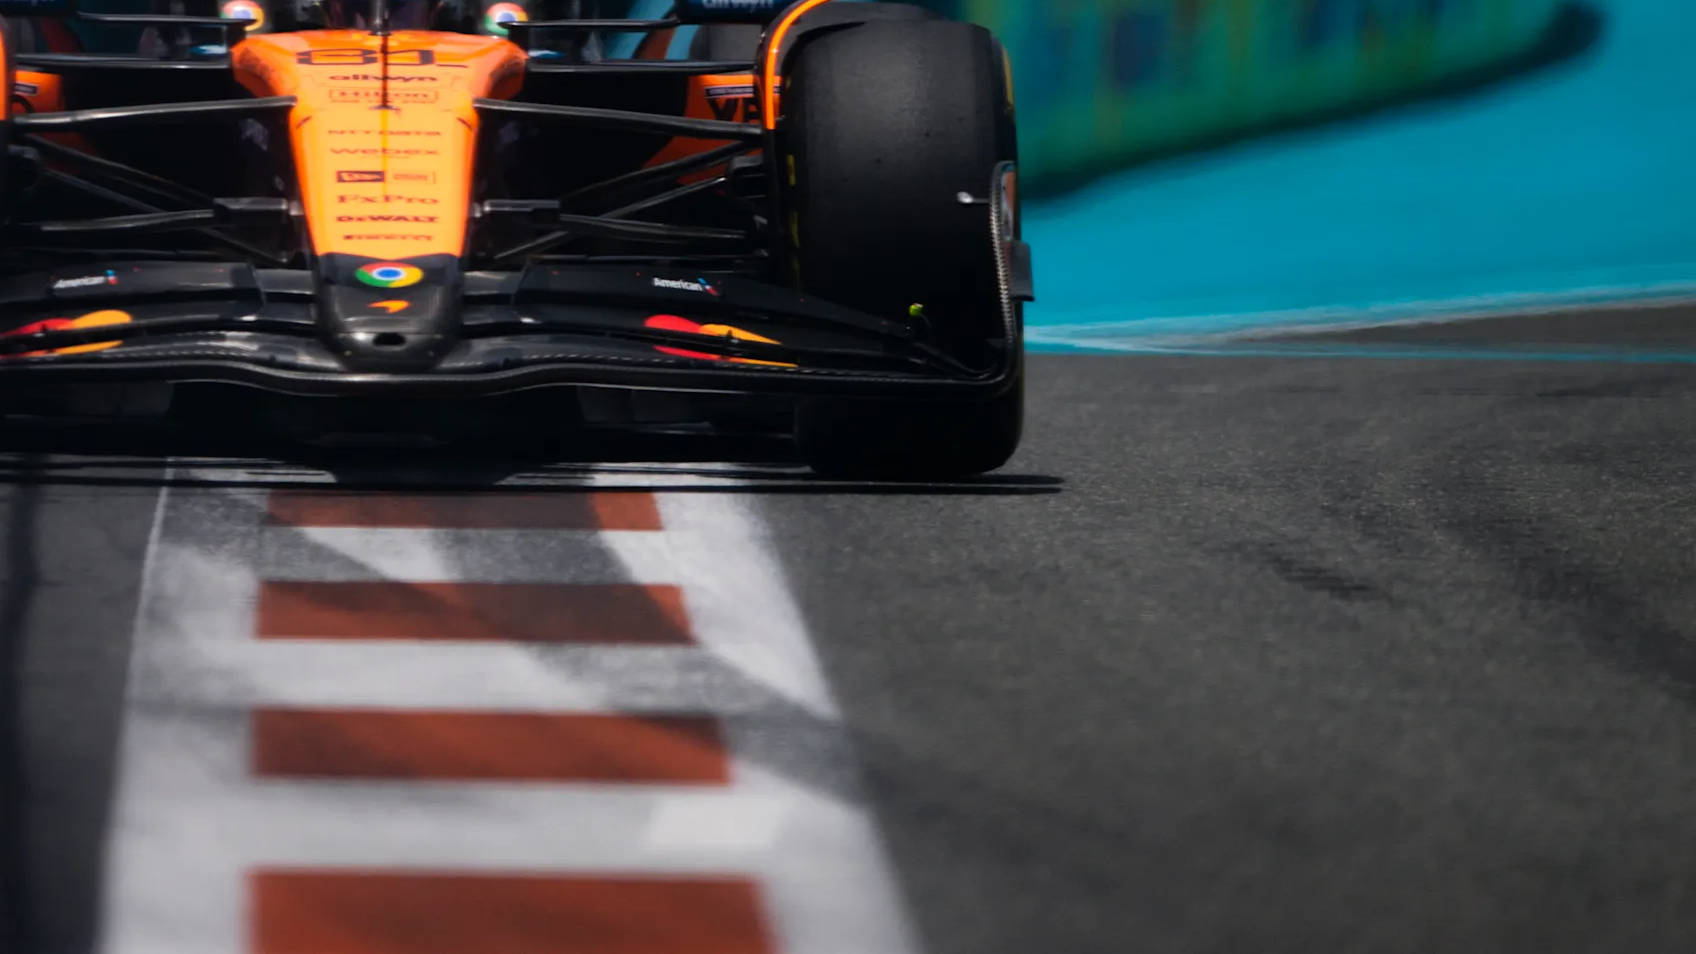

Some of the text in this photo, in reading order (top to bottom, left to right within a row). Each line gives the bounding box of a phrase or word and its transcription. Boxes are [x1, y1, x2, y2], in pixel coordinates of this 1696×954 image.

[328, 73, 438, 83] allwyn
[337, 194, 439, 205] FxPro
[52, 275, 105, 289] American
[653, 277, 703, 292] American
